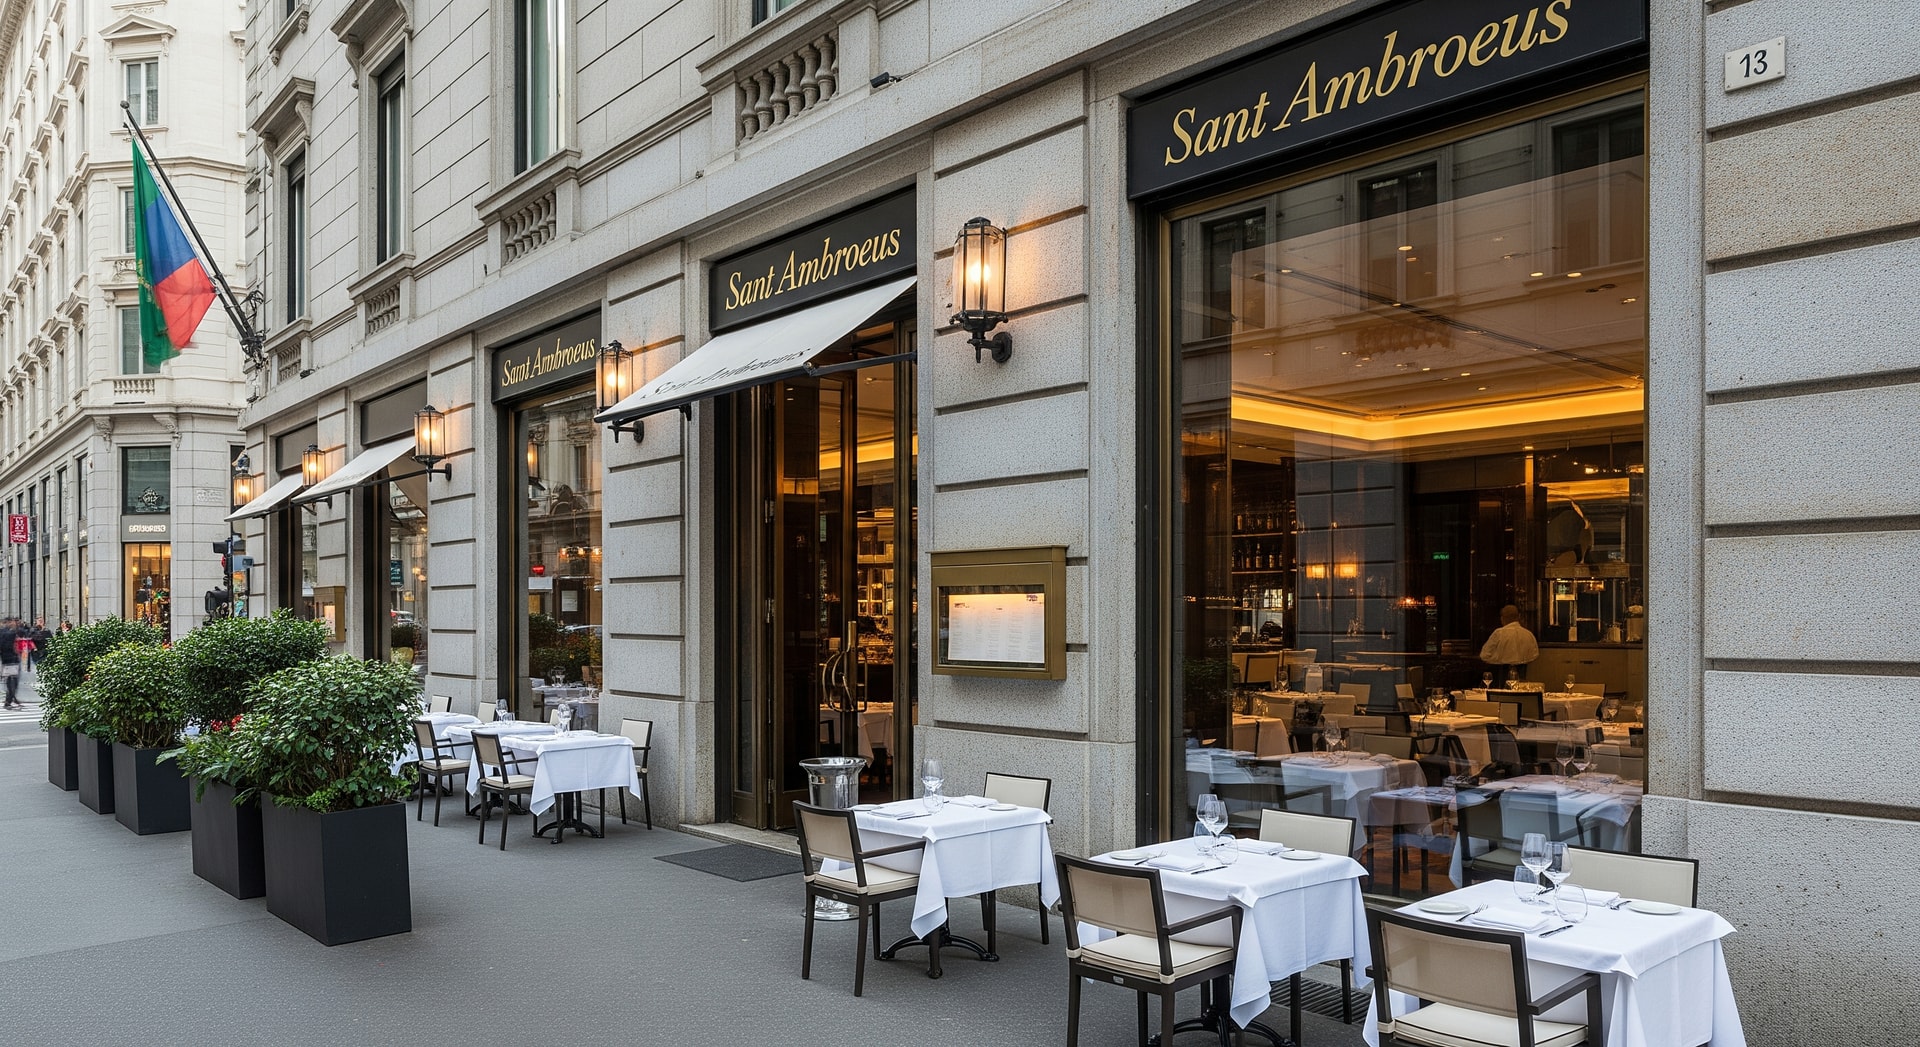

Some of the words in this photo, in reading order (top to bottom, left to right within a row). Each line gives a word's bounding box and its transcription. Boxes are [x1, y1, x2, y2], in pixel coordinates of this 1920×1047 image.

[1164, 90, 1270, 166] Sant
[1271, 0, 1572, 132] Ambroeus
[1739, 49, 1768, 78] 13
[725, 265, 776, 311] Sant
[774, 228, 901, 295] Ambroeus
